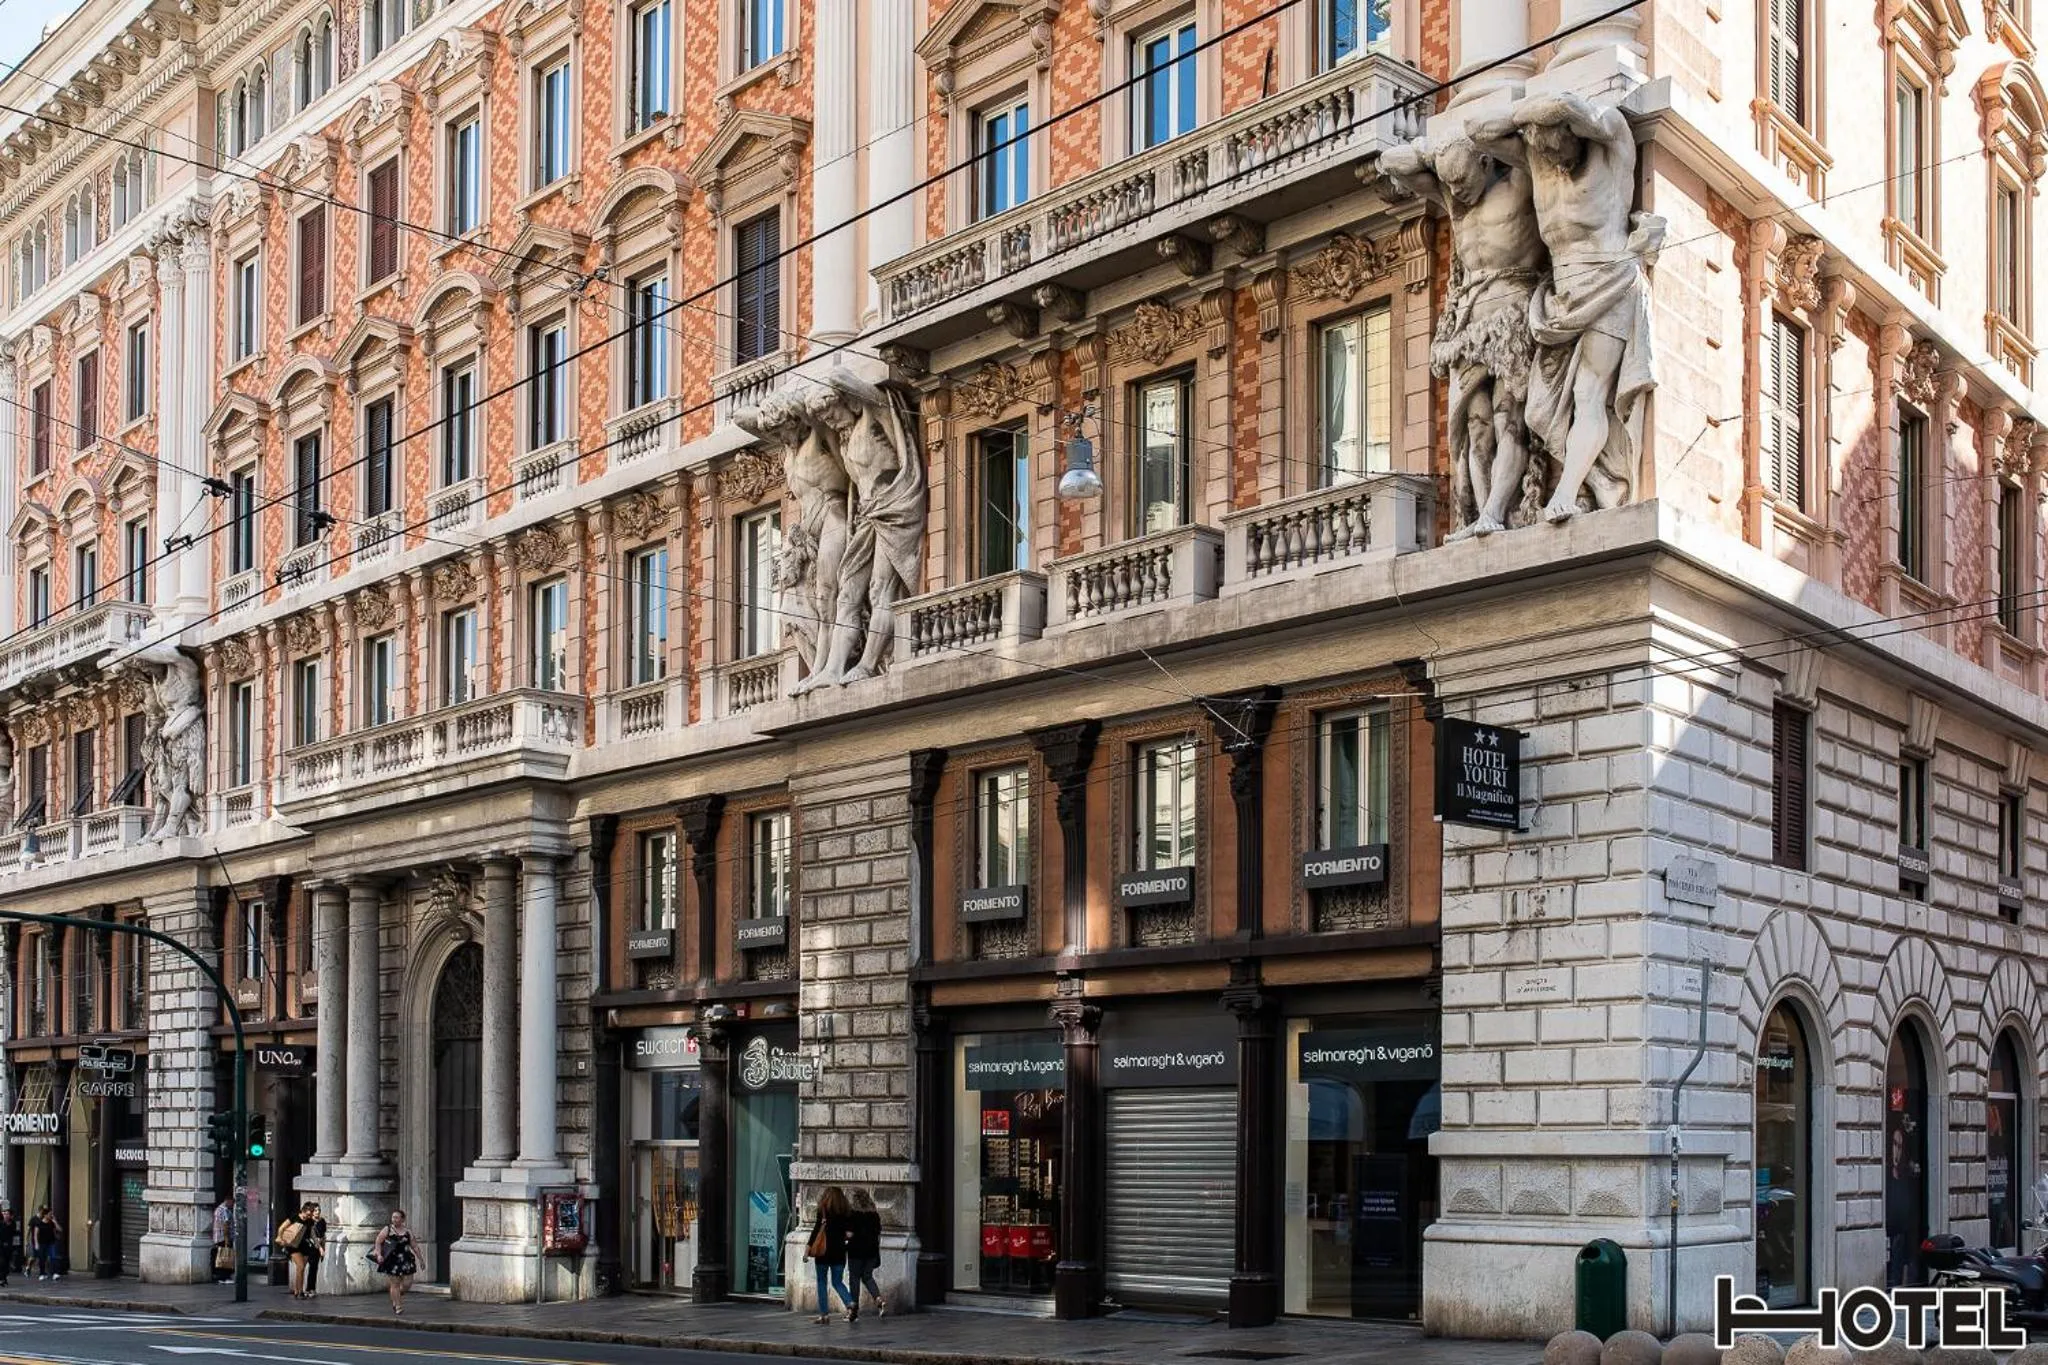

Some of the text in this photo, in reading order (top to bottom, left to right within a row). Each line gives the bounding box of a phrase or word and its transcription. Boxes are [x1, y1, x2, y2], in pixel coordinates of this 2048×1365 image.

[1463, 746, 1508, 770] HOTEL
[1464, 764, 1507, 787] YOURI
[1467, 785, 1514, 804] Magnifico
[1304, 856, 1381, 877] FORMENTO
[1121, 877, 1187, 896] FORMENTO
[963, 895, 1020, 912] FORMENTO
[738, 924, 783, 940] FORMENTO
[629, 937, 669, 950] FORMENTO
[1176, 1053, 1185, 1066] &
[1377, 1046, 1387, 1060] &
[1023, 1059, 1031, 1071] &
[3, 1112, 59, 1132] FORMENTO
[115, 1149, 144, 1160] PASCUCCI
